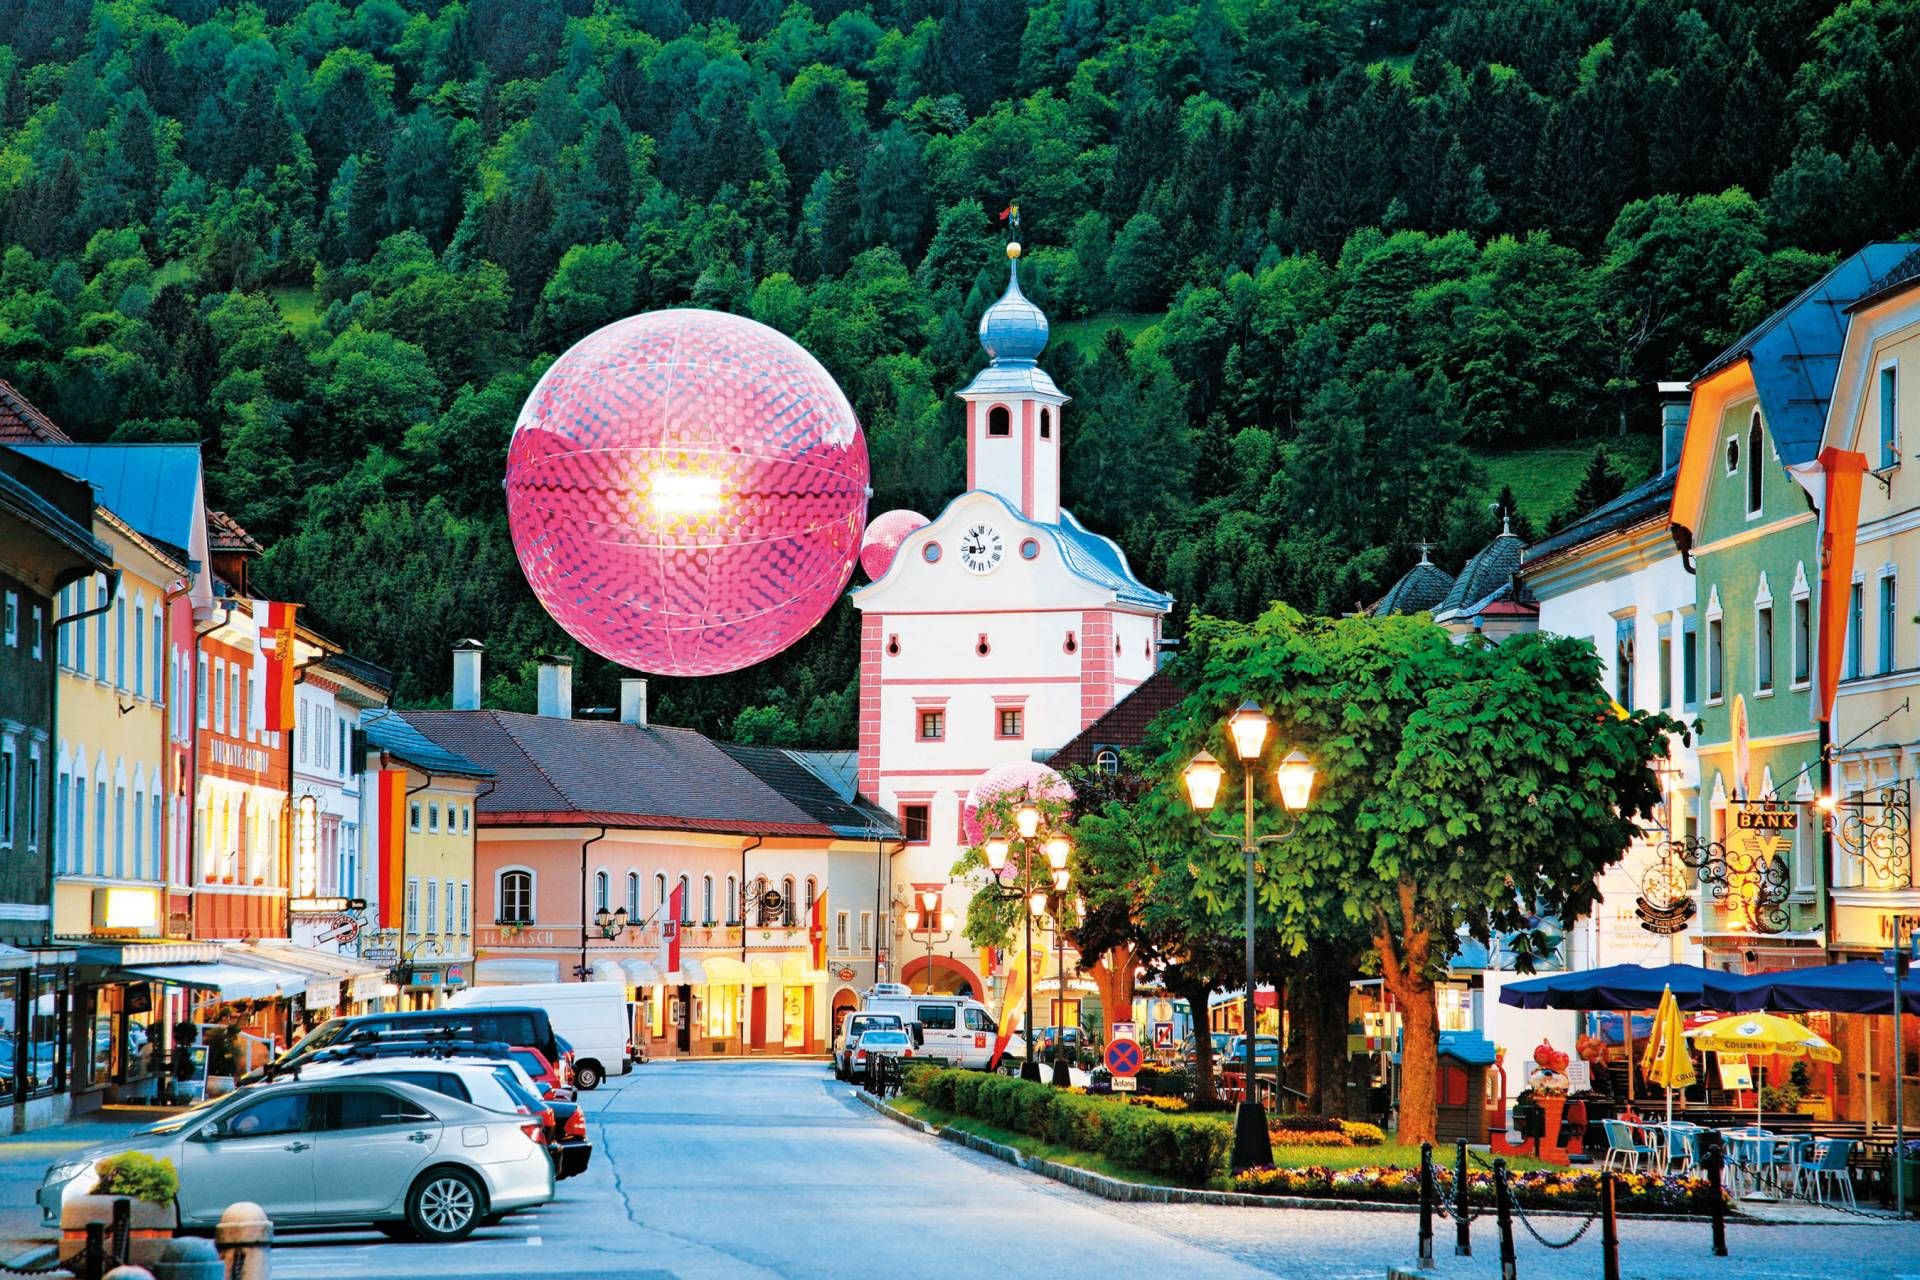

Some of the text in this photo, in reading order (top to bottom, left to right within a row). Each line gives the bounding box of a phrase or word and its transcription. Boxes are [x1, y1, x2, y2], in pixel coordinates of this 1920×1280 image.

[1741, 814, 1793, 827] BANK
[1724, 1040, 1766, 1049] COLUMBIA
[1113, 1078, 1135, 1090] Anfang
